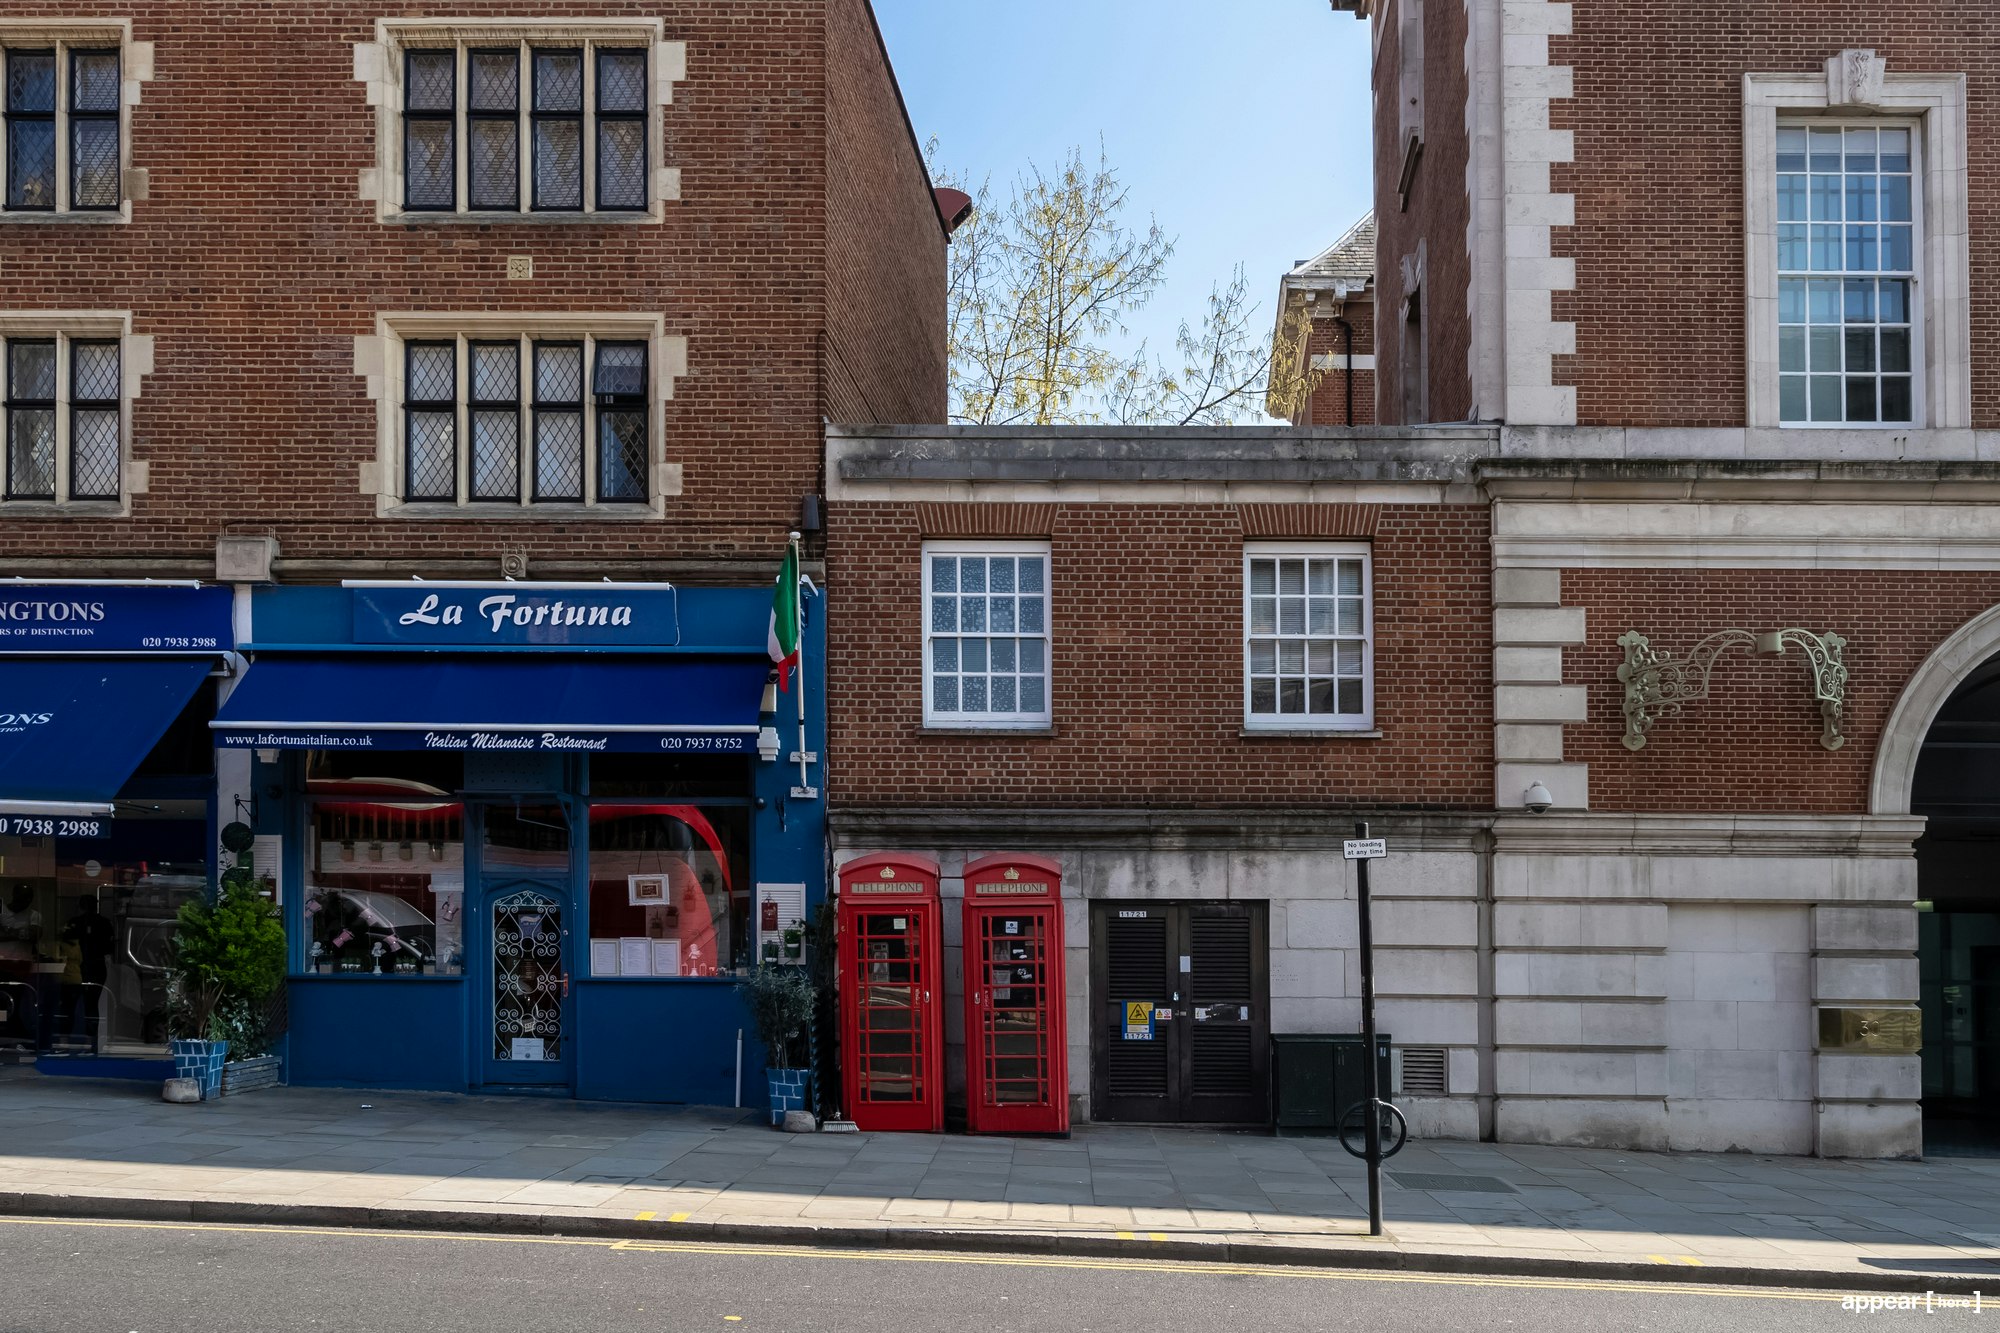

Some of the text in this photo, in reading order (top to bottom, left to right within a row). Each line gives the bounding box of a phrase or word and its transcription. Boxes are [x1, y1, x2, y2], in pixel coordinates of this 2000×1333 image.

[399, 593, 632, 633] La Fortuna
[14, 628, 28, 636] OF
[31, 628, 95, 636] DISTINCTION
[142, 637, 217, 647] 020 7938 2988
[225, 733, 373, 746] www.lafortunaitalian.co.uk
[424, 731, 608, 750] Italian Milanaise Restaurant
[661, 737, 742, 749] 020 7937 8752
[13, 818, 54, 836] 7938
[58, 819, 100, 837] 2988
[855, 882, 922, 892] TELEPHONE
[980, 883, 1046, 893] TELEPHONE
[1860, 1020, 1880, 1037] 30
